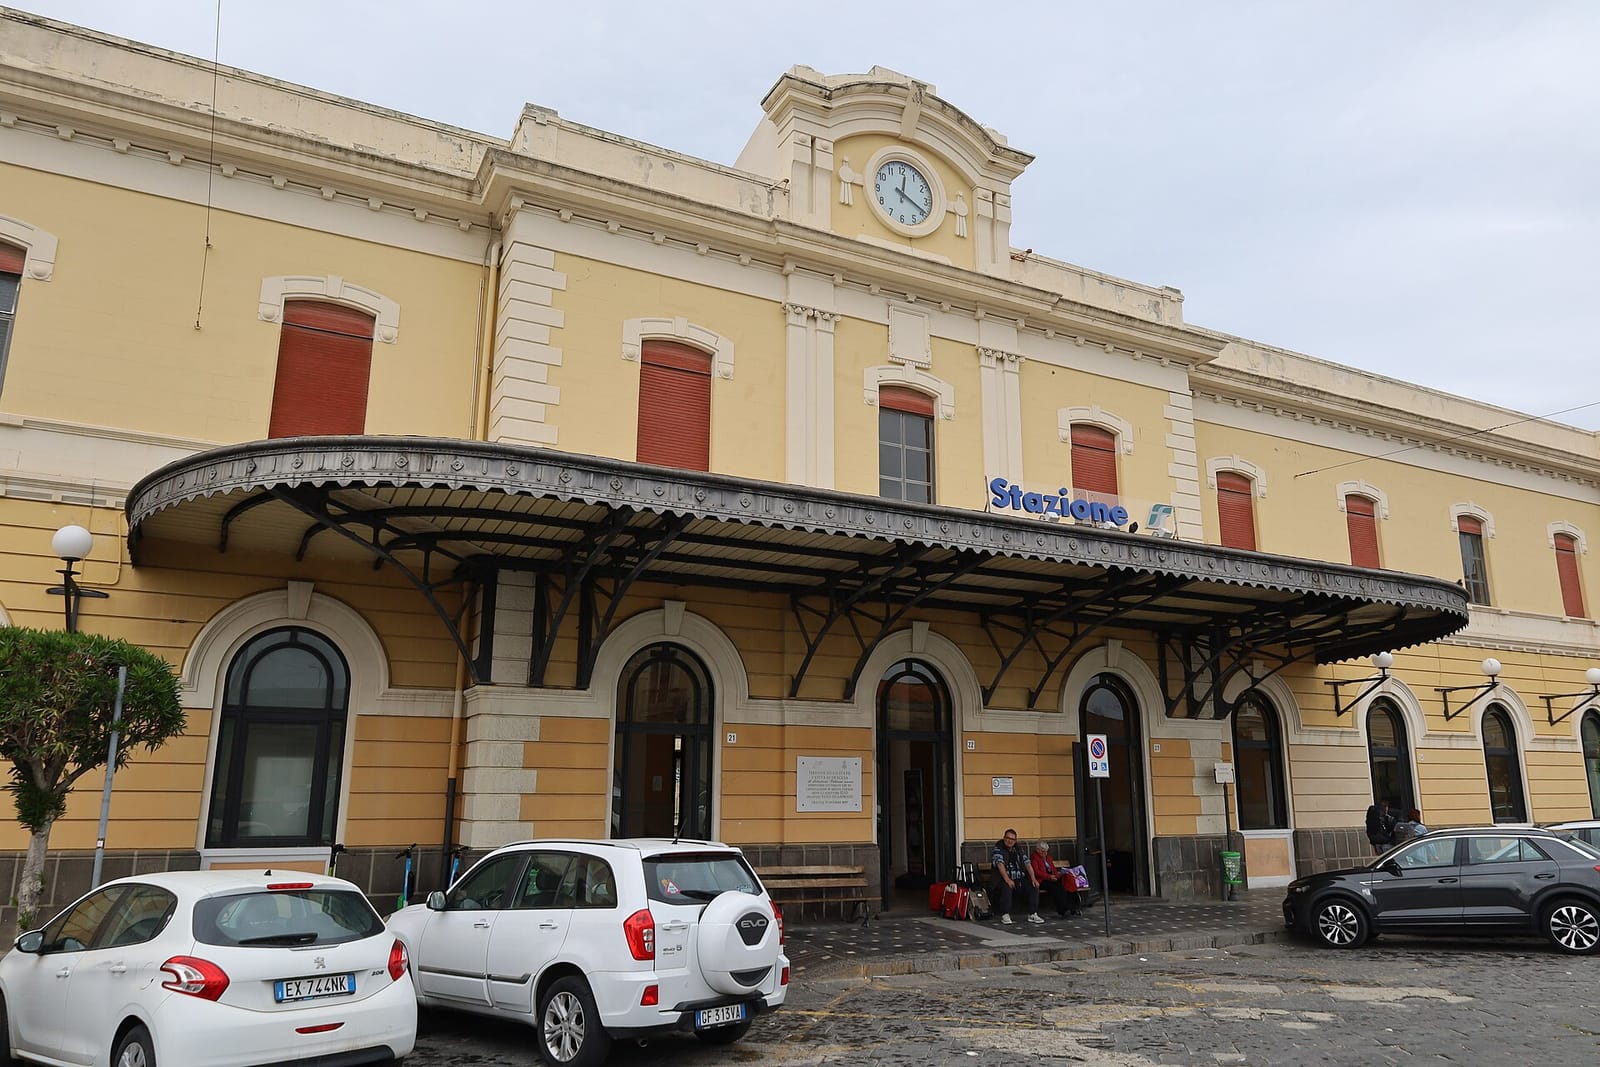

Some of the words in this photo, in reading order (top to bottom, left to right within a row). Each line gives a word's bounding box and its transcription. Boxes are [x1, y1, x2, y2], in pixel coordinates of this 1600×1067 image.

[888, 167, 893, 176] 11
[898, 166, 906, 176] 12
[880, 173, 886, 182] 10
[876, 184, 880, 192] 9
[920, 185, 924, 193] 2
[880, 196, 884, 205] 8
[924, 198, 928, 206] 3
[888, 208, 894, 216] 7
[900, 214, 904, 223] 6
[912, 214, 916, 222] 5
[990, 477, 1128, 526] Stazione
[740, 918, 767, 928] EVO
[286, 982, 302, 997] EX
[307, 976, 346, 994] 744NK
[702, 1009, 712, 1024] GF
[714, 1004, 740, 1022] 313VA
